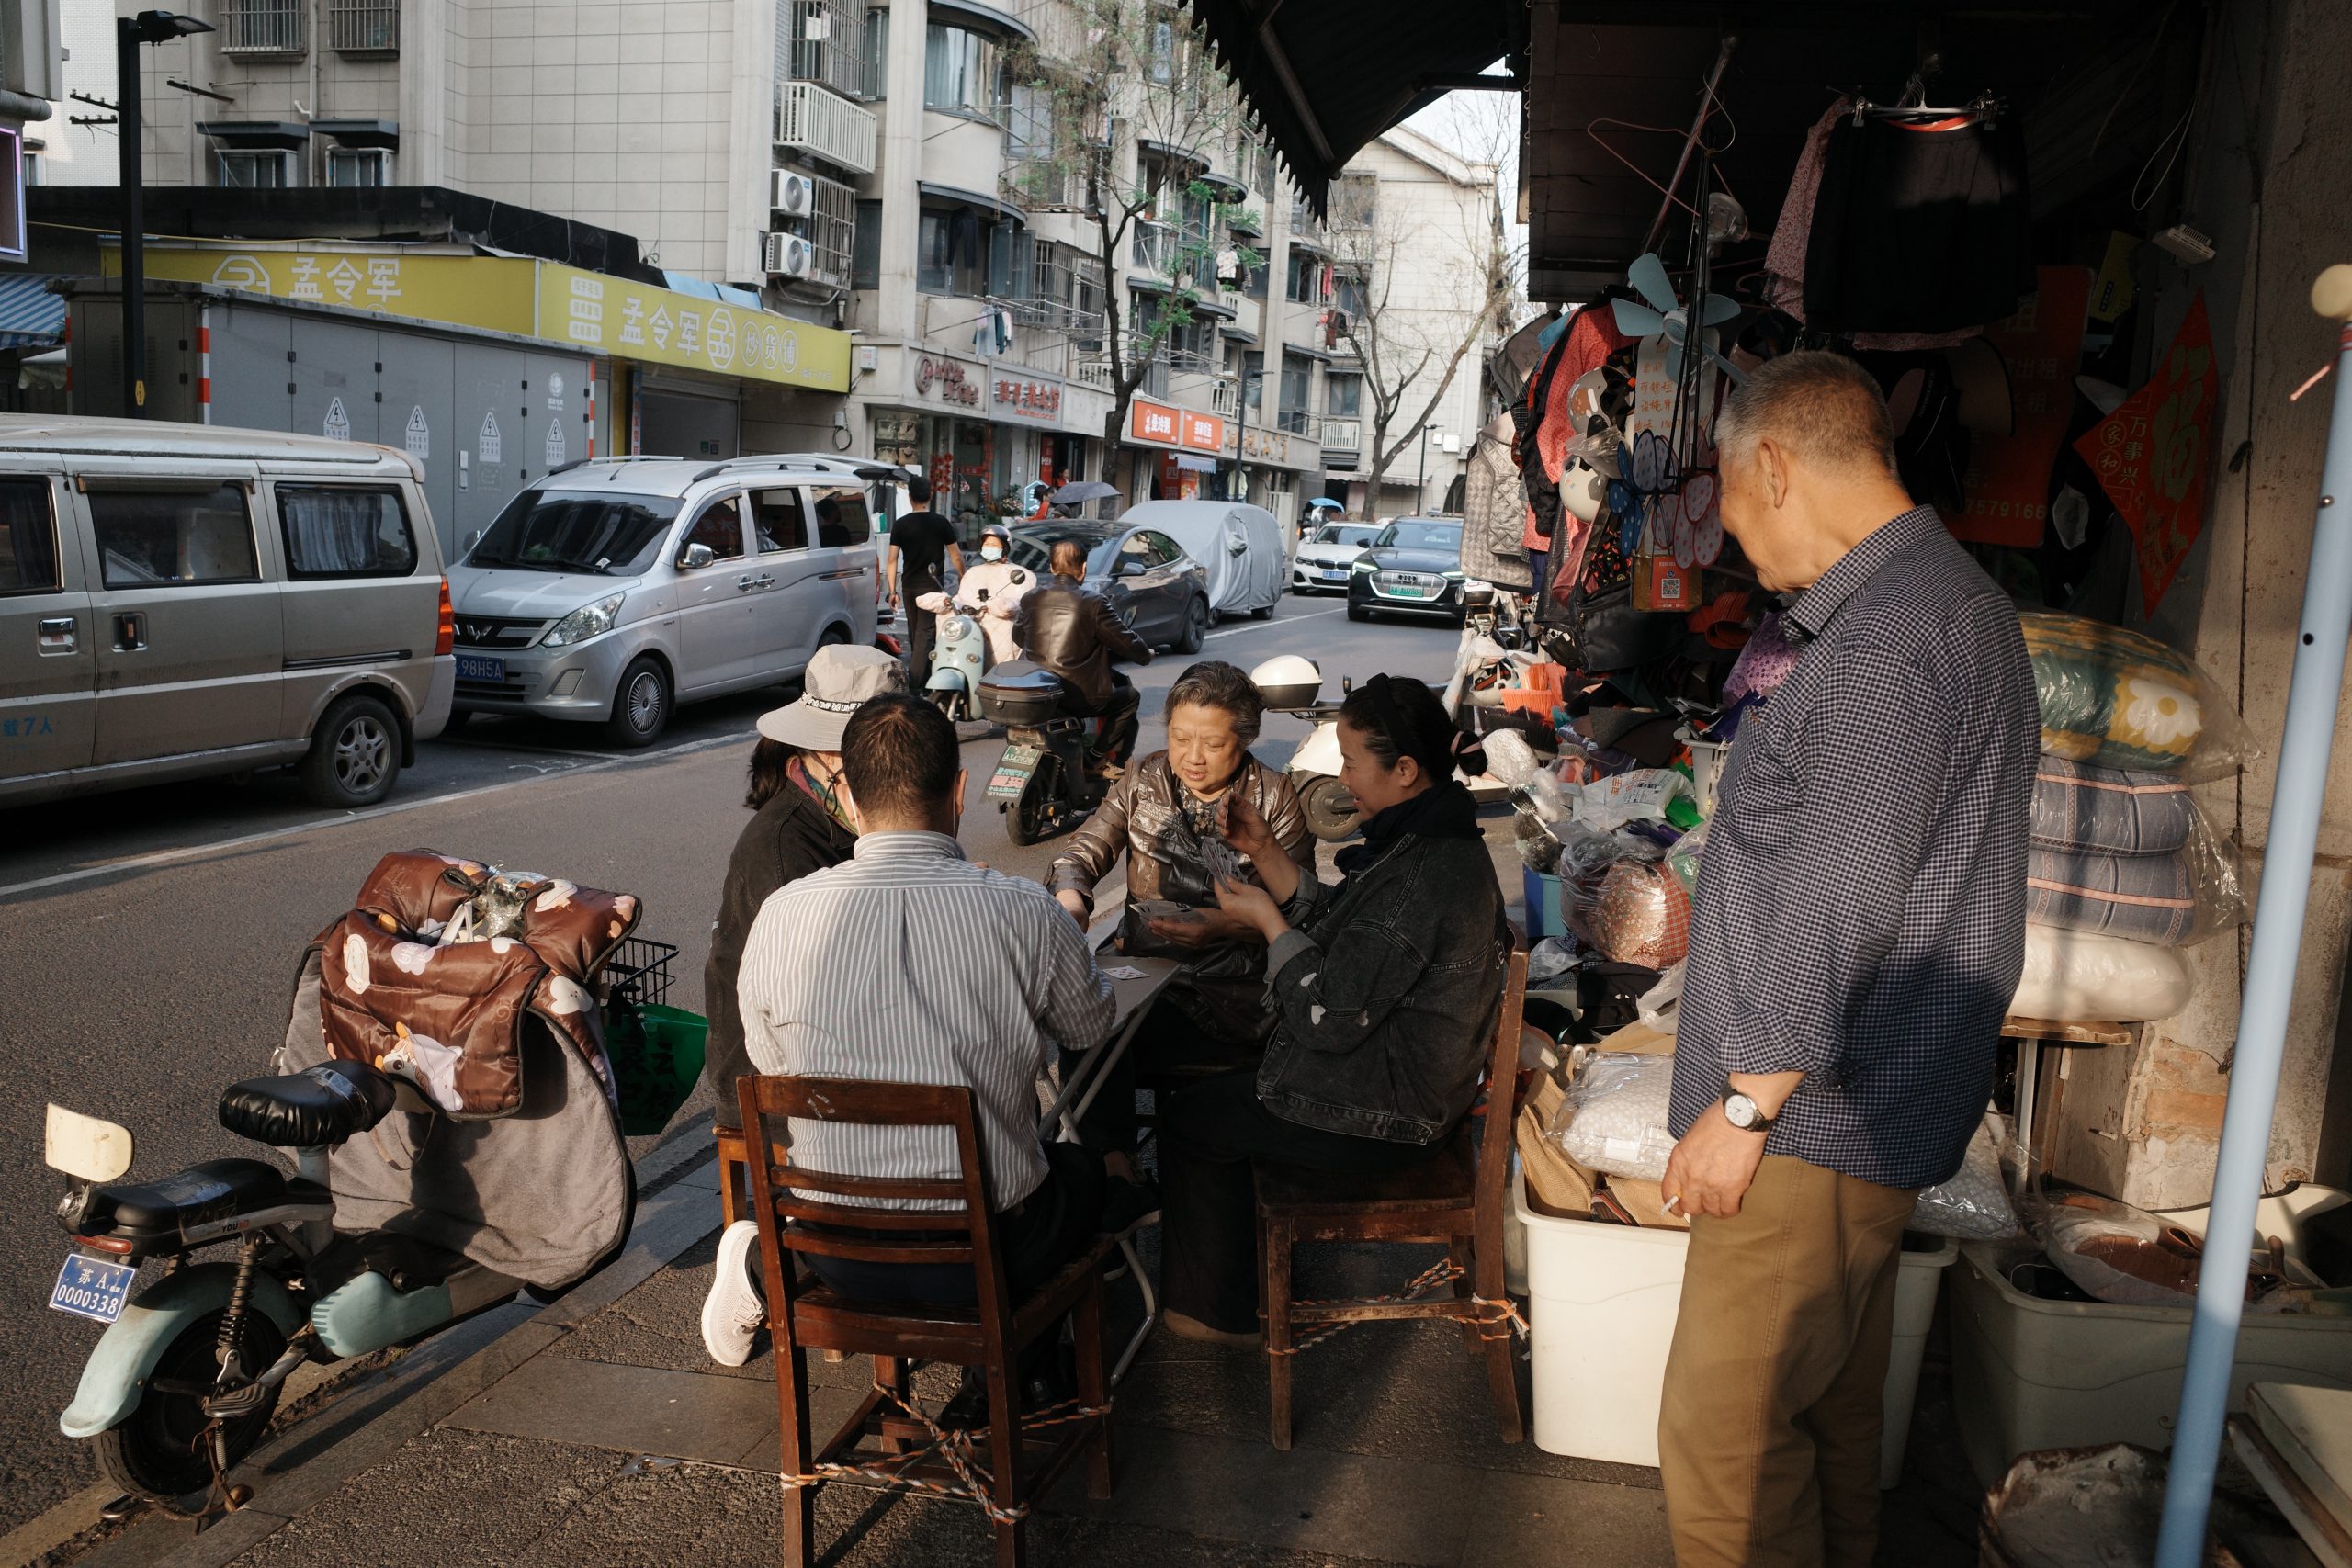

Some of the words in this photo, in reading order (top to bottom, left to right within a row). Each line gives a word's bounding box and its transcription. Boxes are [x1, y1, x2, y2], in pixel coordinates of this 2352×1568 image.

[288, 256, 402, 303] 孟令军
[618, 296, 704, 358] 孟令军
[744, 329, 796, 366] 炒货铺
[2098, 423, 2125, 474] 家和
[2150, 344, 2211, 505] 福
[2118, 416, 2147, 487] 万事兴
[57, 1284, 119, 1314] 0000338
[77, 1267, 94, 1285] 苏
[96, 1271, 107, 1290] A
